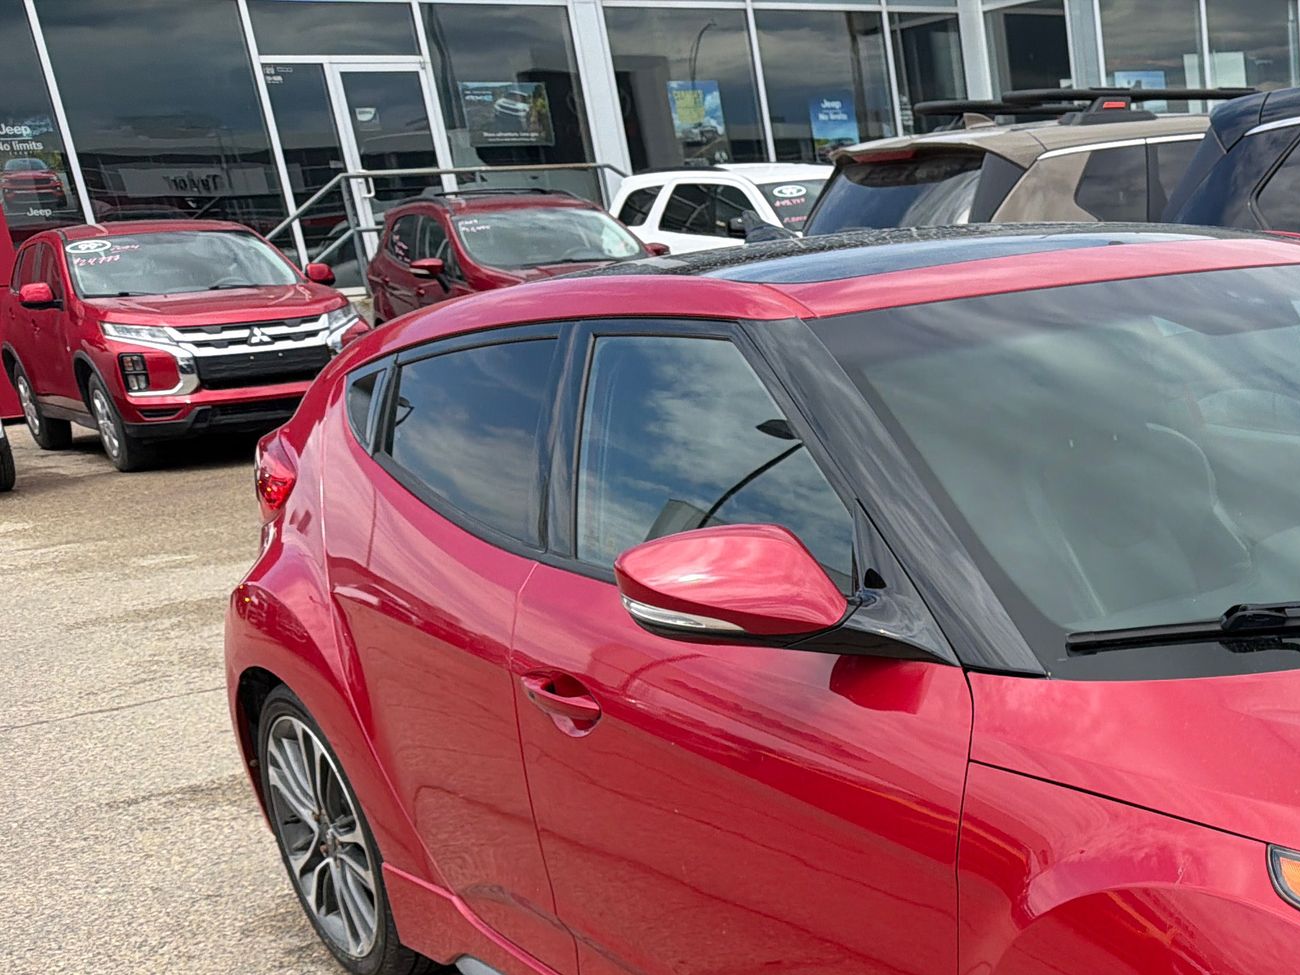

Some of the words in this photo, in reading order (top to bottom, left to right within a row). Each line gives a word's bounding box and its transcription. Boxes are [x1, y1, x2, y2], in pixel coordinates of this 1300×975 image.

[821, 99, 842, 109] Jeep
[0, 124, 32, 136] Jeep
[12, 141, 44, 150] limits
[27, 207, 52, 216] Jeep
